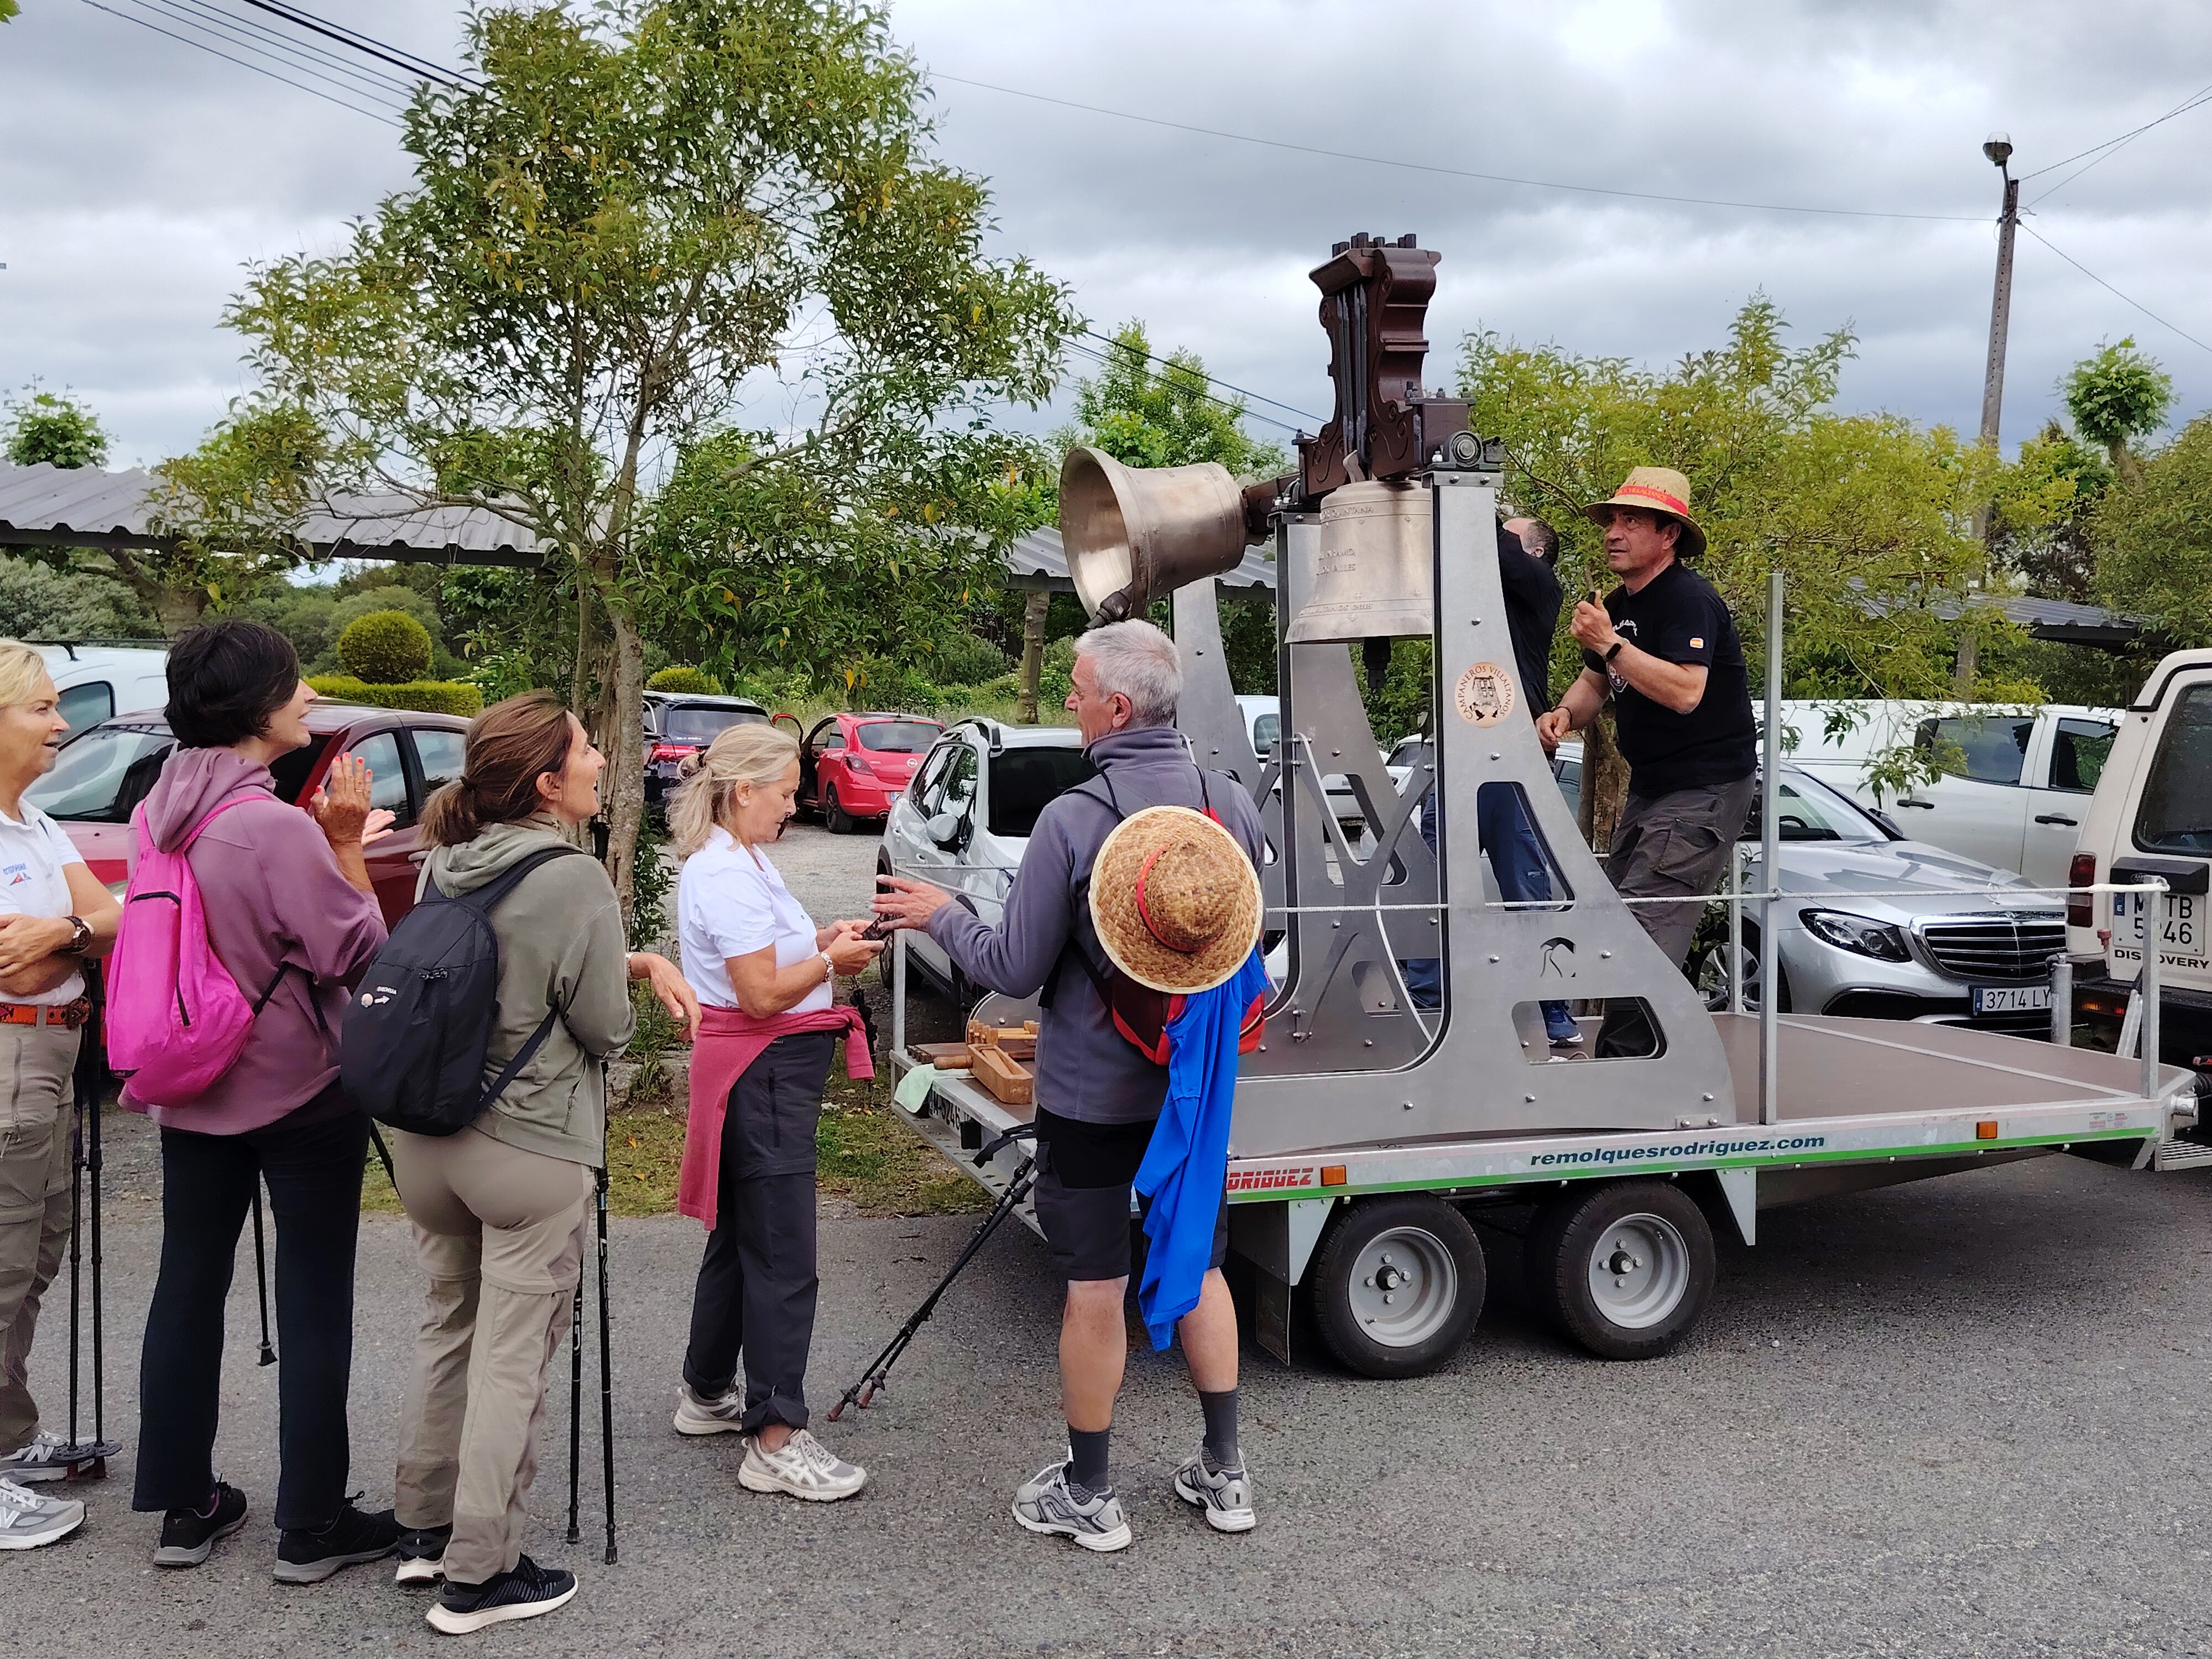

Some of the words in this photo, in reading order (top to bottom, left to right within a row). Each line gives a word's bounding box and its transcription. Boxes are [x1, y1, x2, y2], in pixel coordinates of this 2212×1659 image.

[1458, 665, 1486, 719] CAMPANEROS
[1489, 666, 1512, 716] VILLALTANOS
[2134, 917, 2193, 945] 546
[2114, 950, 2210, 969] DISVERY
[1986, 990, 2027, 1009] 3714
[2033, 989, 2051, 1008] LY
[1530, 1136, 1825, 1165] remolquesrodriguez.com
[1227, 1167, 1314, 1190] DRIGUEZ
